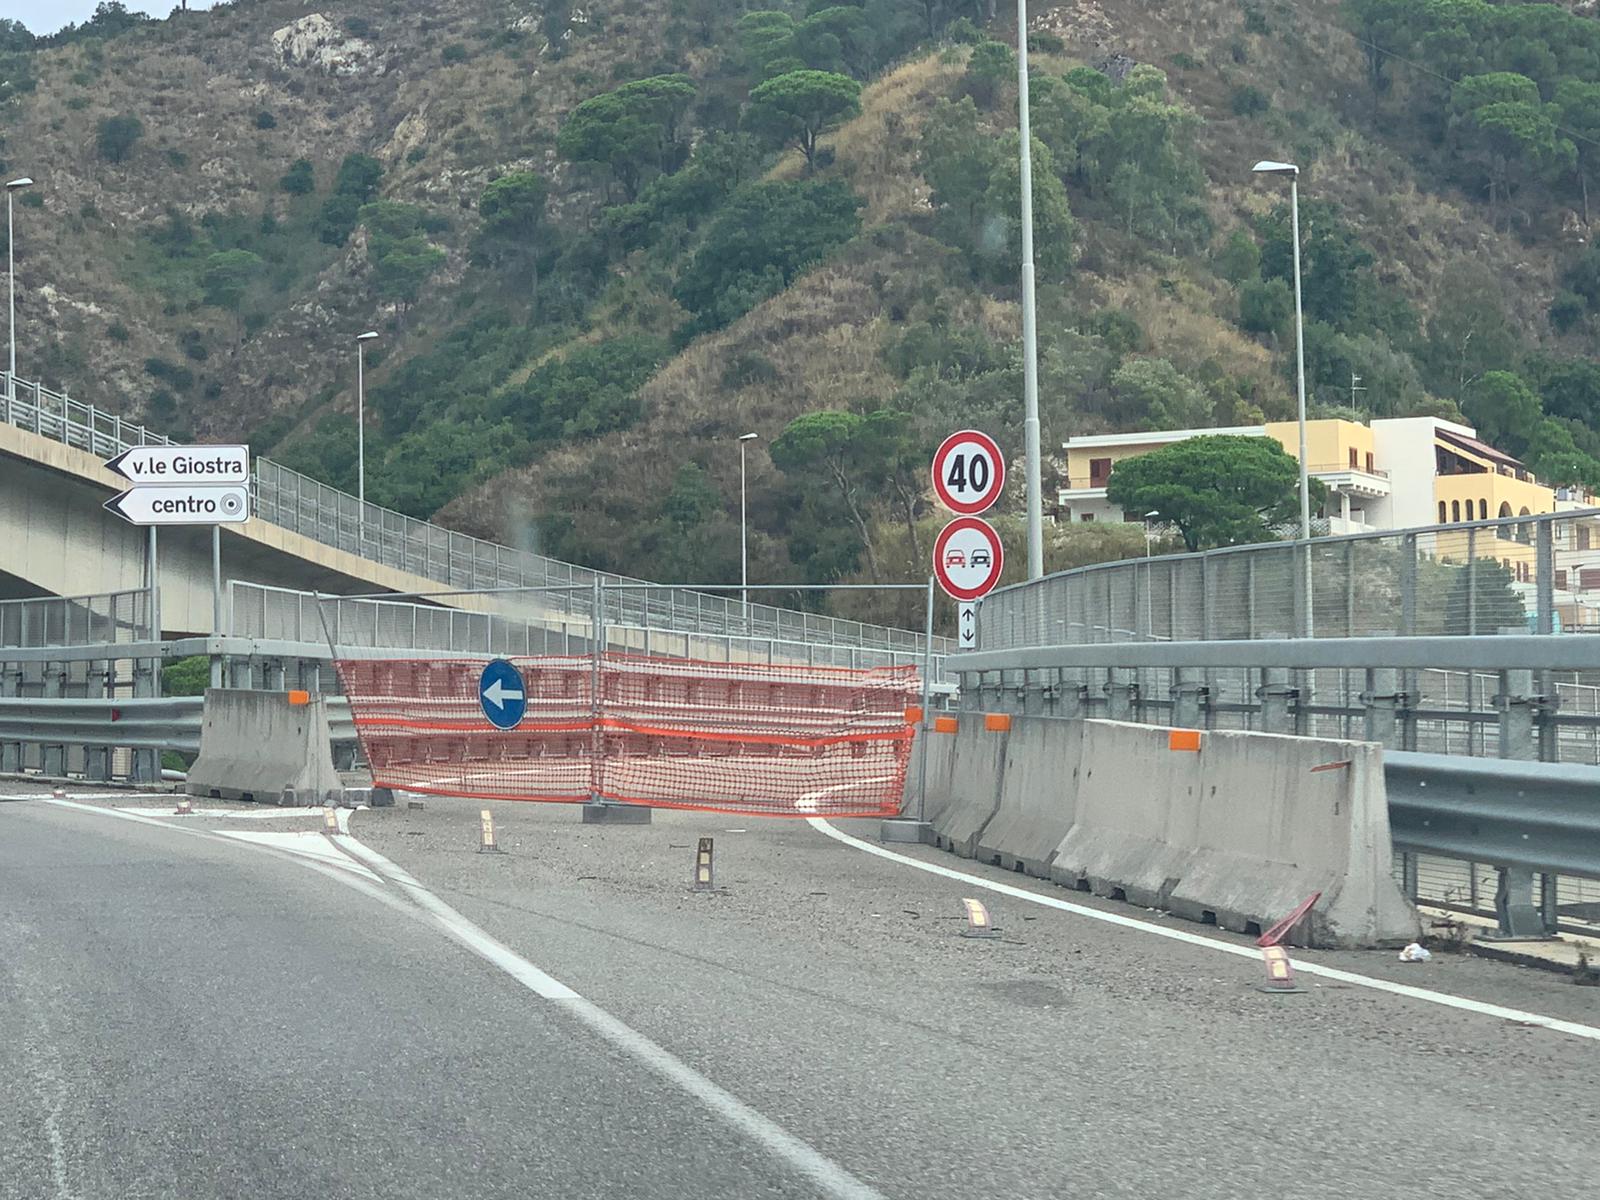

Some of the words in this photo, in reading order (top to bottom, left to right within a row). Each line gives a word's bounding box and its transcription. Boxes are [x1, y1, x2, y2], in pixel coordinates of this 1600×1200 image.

[133, 457, 166, 474] v.le
[172, 456, 243, 474] Giostra
[947, 454, 989, 493] 40
[152, 495, 216, 513] centro
